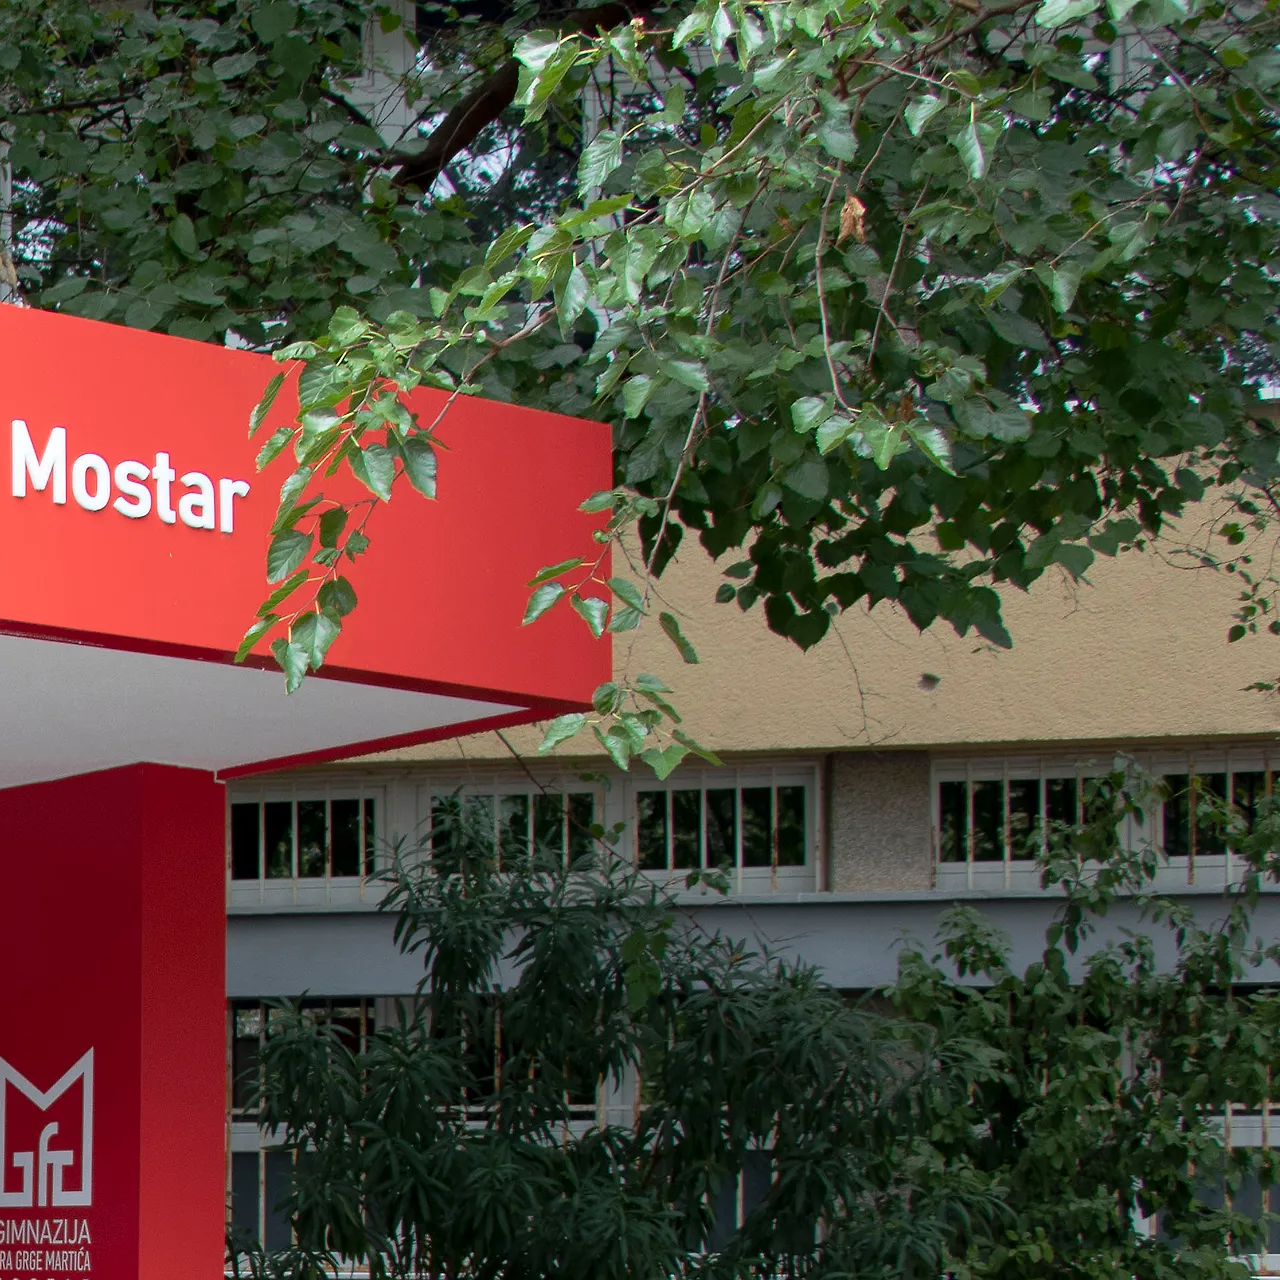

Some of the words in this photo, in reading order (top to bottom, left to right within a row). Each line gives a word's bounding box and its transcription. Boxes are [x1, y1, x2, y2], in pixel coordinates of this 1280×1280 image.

[11, 419, 252, 535] Mostar
[15, 1250, 43, 1271] GRGE
[45, 1247, 91, 1272] MARTIĆA
